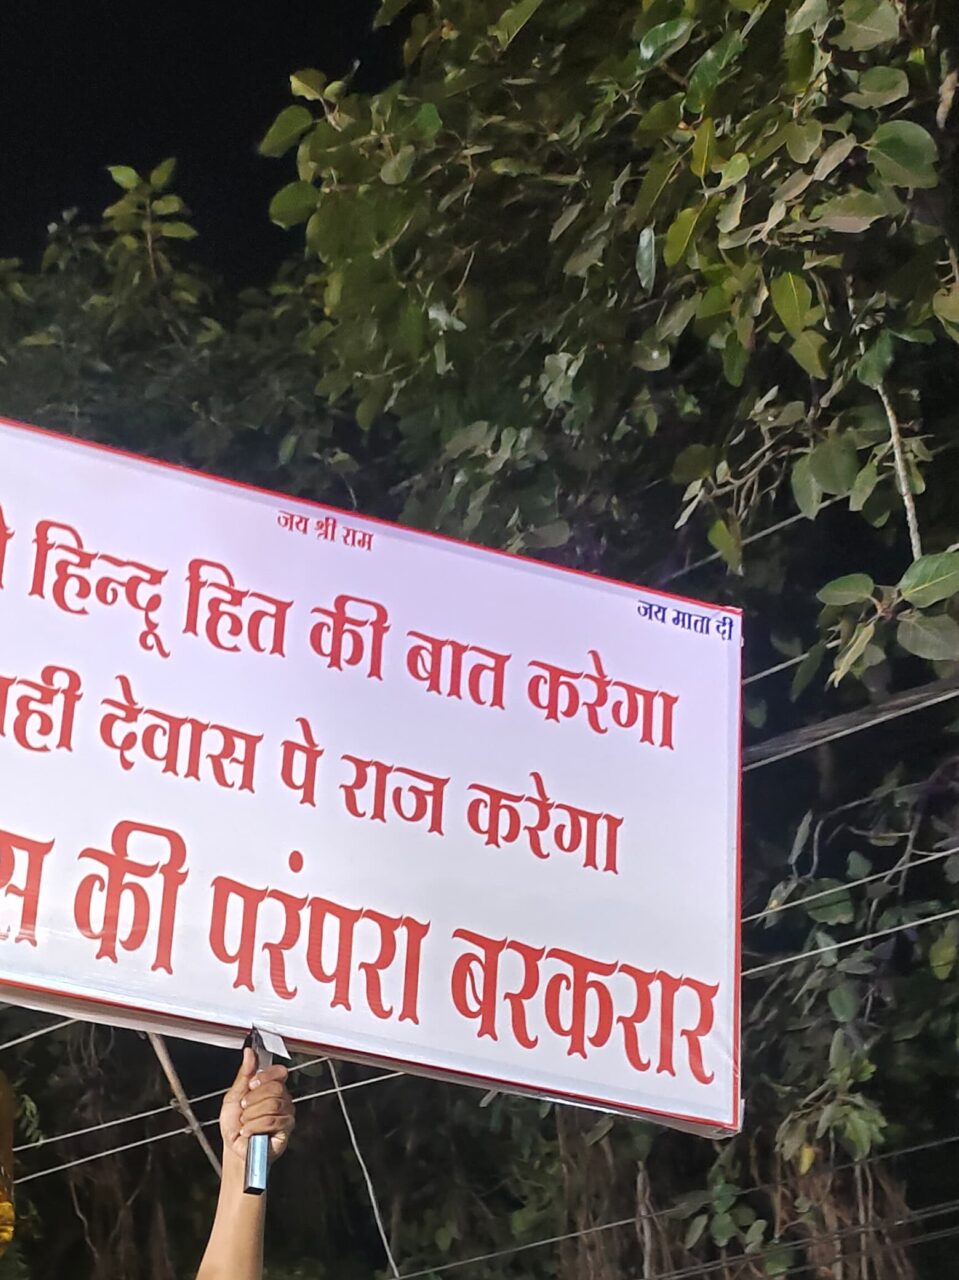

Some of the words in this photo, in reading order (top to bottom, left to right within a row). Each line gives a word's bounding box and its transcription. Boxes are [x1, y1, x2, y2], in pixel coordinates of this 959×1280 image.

[277, 510, 310, 535] जय
[315, 516, 338, 542] श्री
[342, 526, 374, 551] राम
[637, 600, 667, 624] जय
[672, 609, 711, 635] माता
[715, 616, 733, 640] दी
[28, 519, 171, 659] हिन्दू
[182, 558, 294, 658] हित
[309, 593, 391, 682] की
[405, 630, 512, 710] बात
[527, 649, 680, 751] करेगा
[99, 674, 264, 794] देवास
[279, 716, 325, 808] पे
[339, 753, 450, 837] राज
[467, 771, 625, 875] करेगा
[73, 820, 190, 976] की
[208, 850, 431, 1025] परंपरा
[450, 927, 721, 1085] बरकरार
